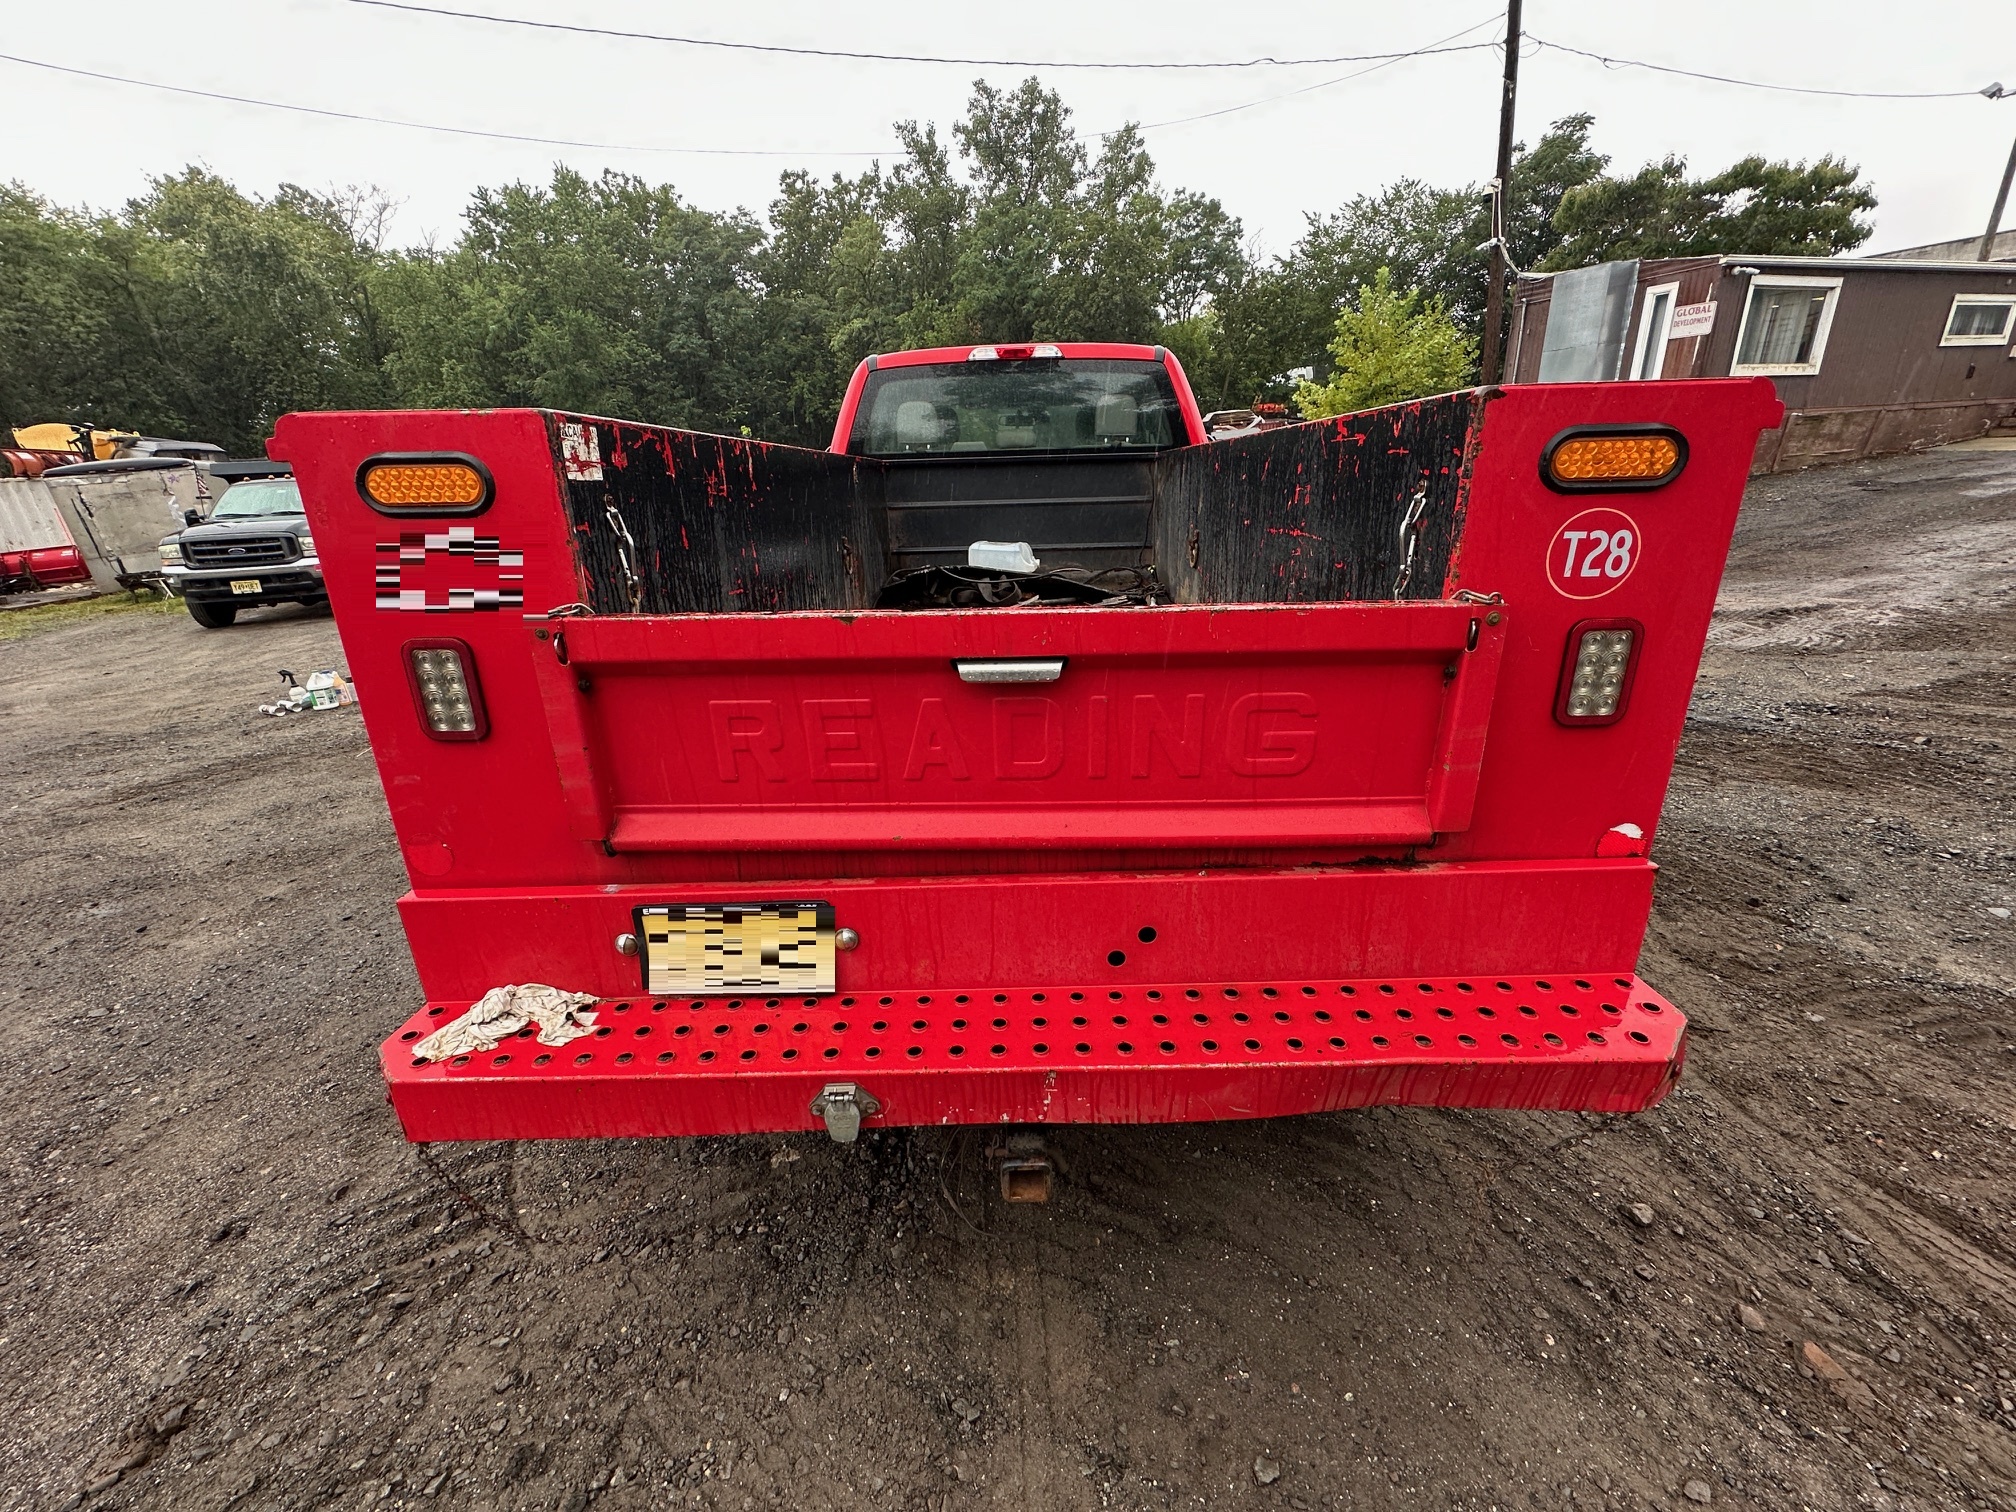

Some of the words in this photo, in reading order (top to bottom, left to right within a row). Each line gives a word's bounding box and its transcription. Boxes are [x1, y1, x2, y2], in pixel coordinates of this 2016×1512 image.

[1673, 316, 1711, 327] DEVELOPMENT
[1677, 305, 1711, 317] GLOBAL
[1563, 529, 1633, 578] T28
[708, 692, 1320, 783] READING
